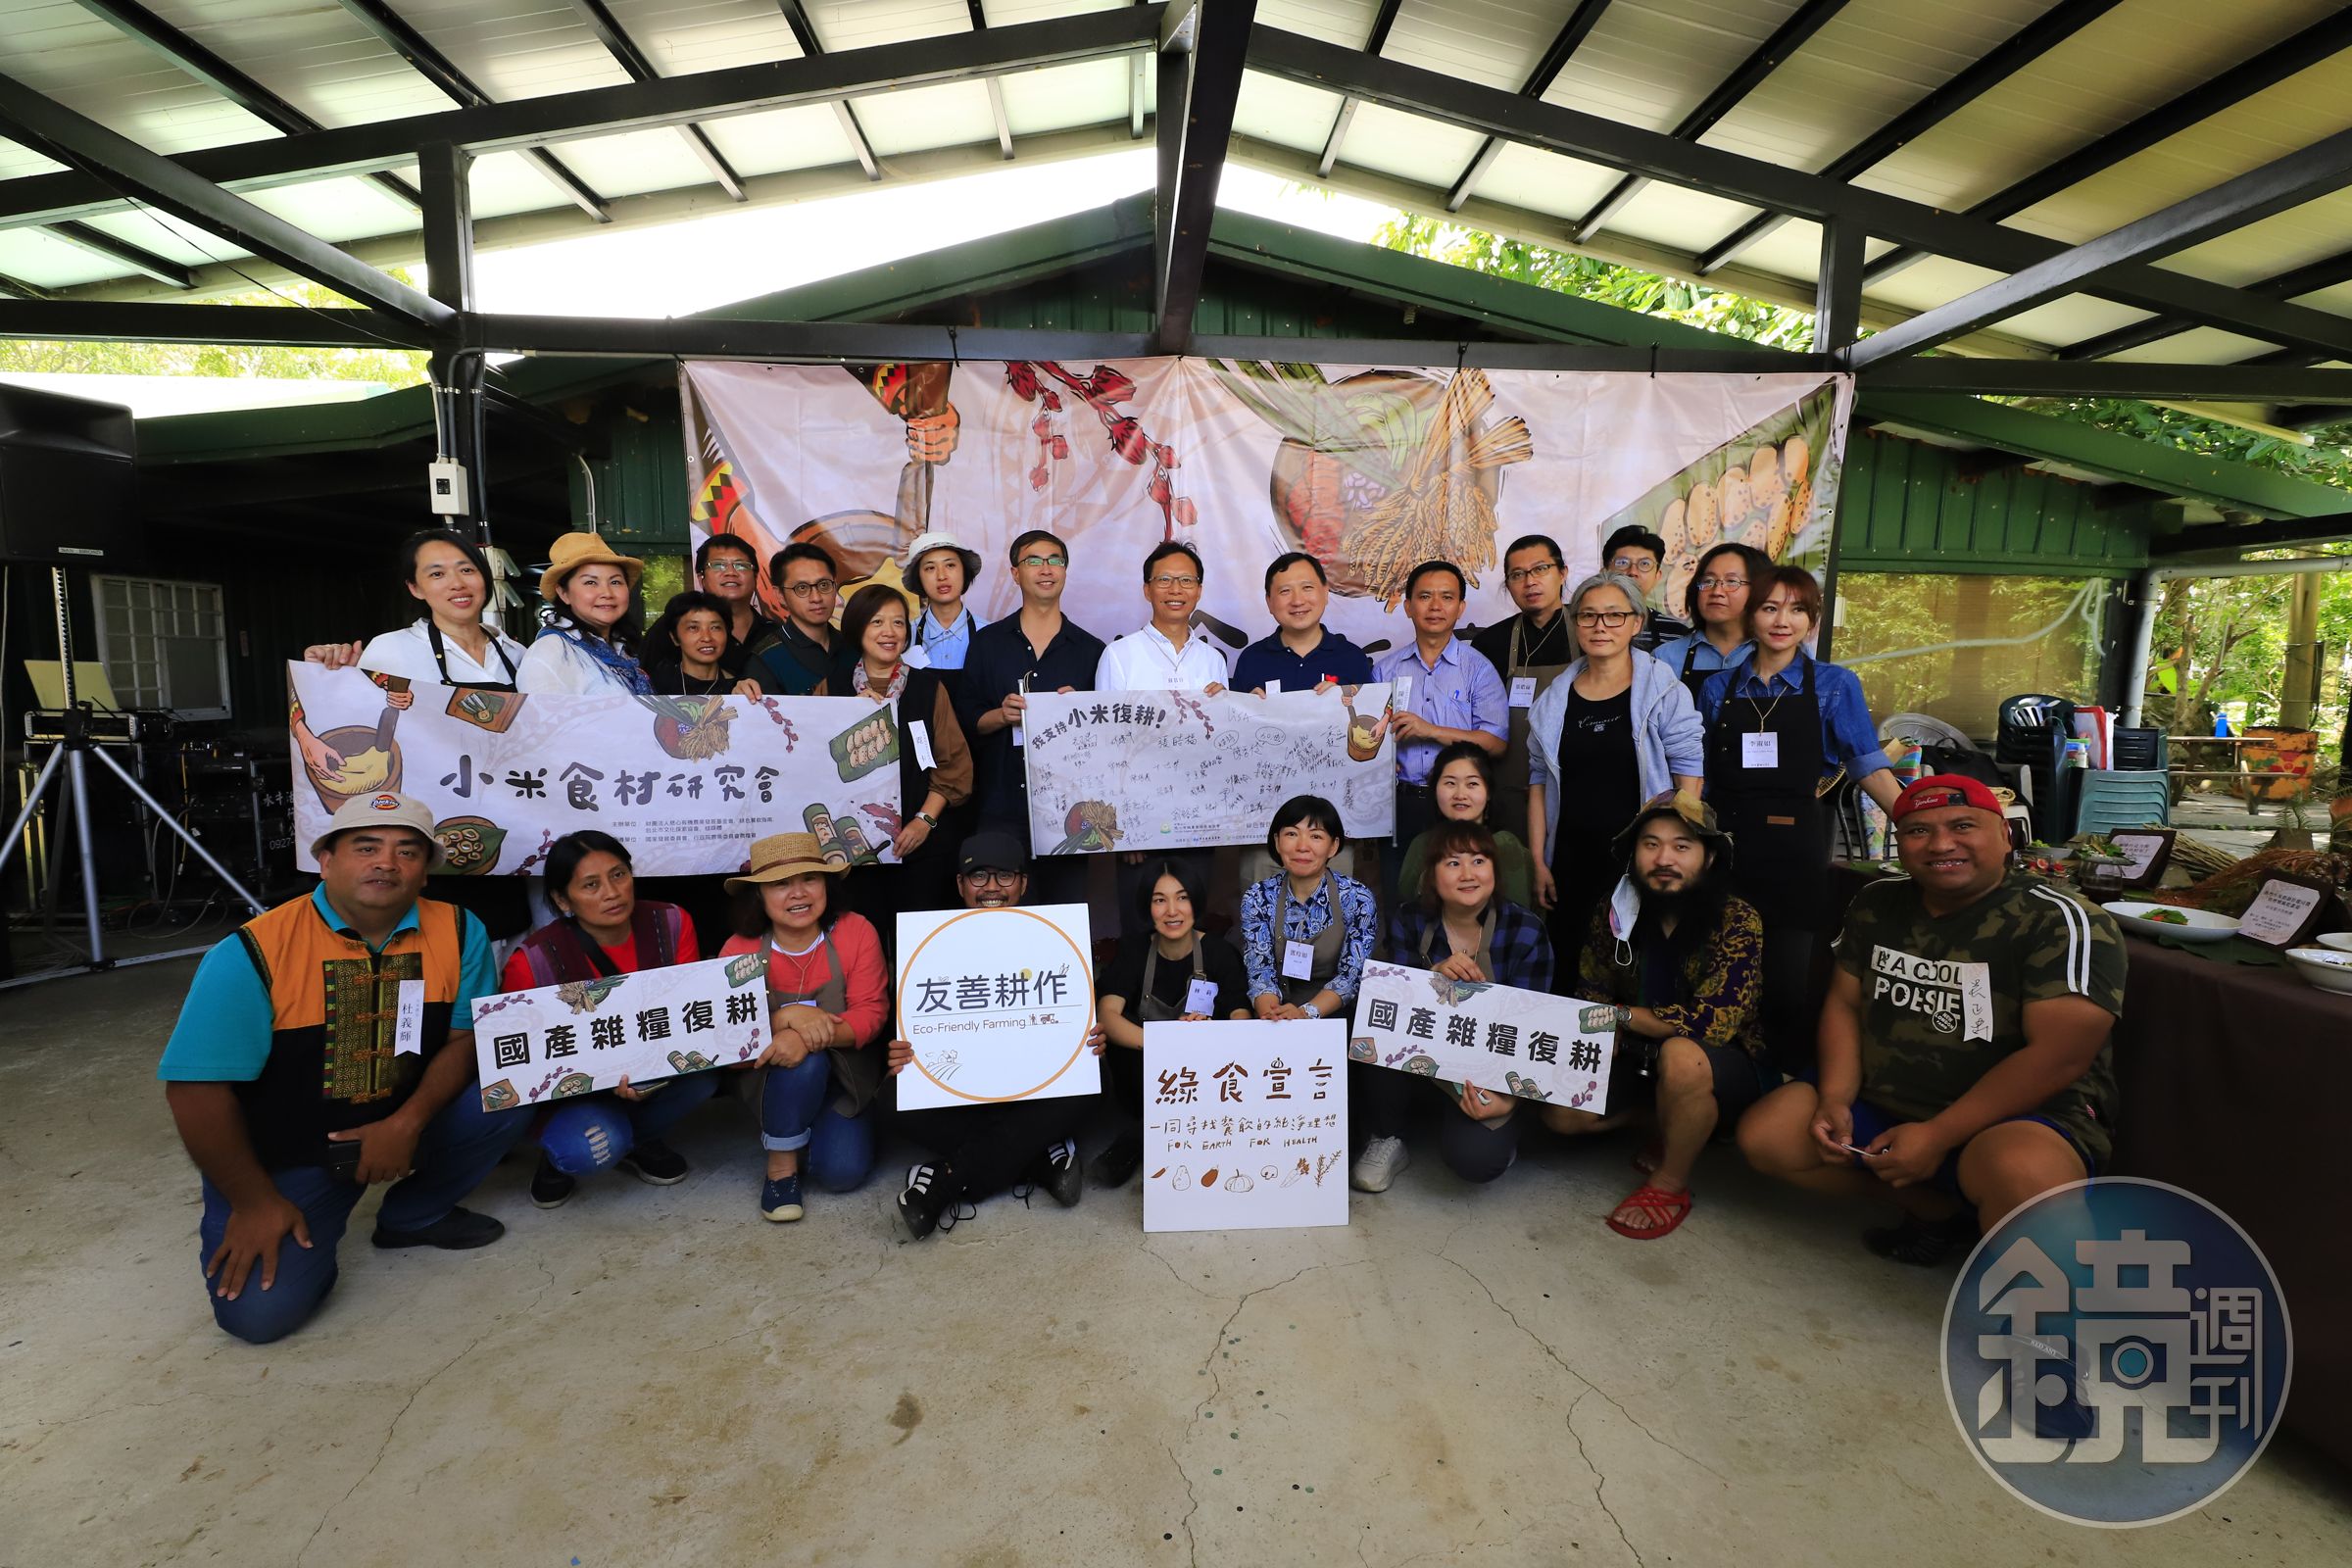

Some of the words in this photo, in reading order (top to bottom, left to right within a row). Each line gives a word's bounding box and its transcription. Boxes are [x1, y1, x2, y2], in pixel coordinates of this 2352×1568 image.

[440, 755, 780, 811] 小米食材研究會
[916, 969, 1068, 1013] 友善耕作
[493, 992, 759, 1070] 國產雜糧復耕
[912, 1020, 980, 1035] Eco-Friendly
[983, 1017, 1026, 1030] Farming
[1367, 998, 1602, 1074] 國產雜糧復耕
[1167, 1139, 1193, 1152] FOR
[1202, 1139, 1232, 1151] EARTH
[1250, 1137, 1271, 1149] FOR
[1284, 1136, 1318, 1148] HEALTH
